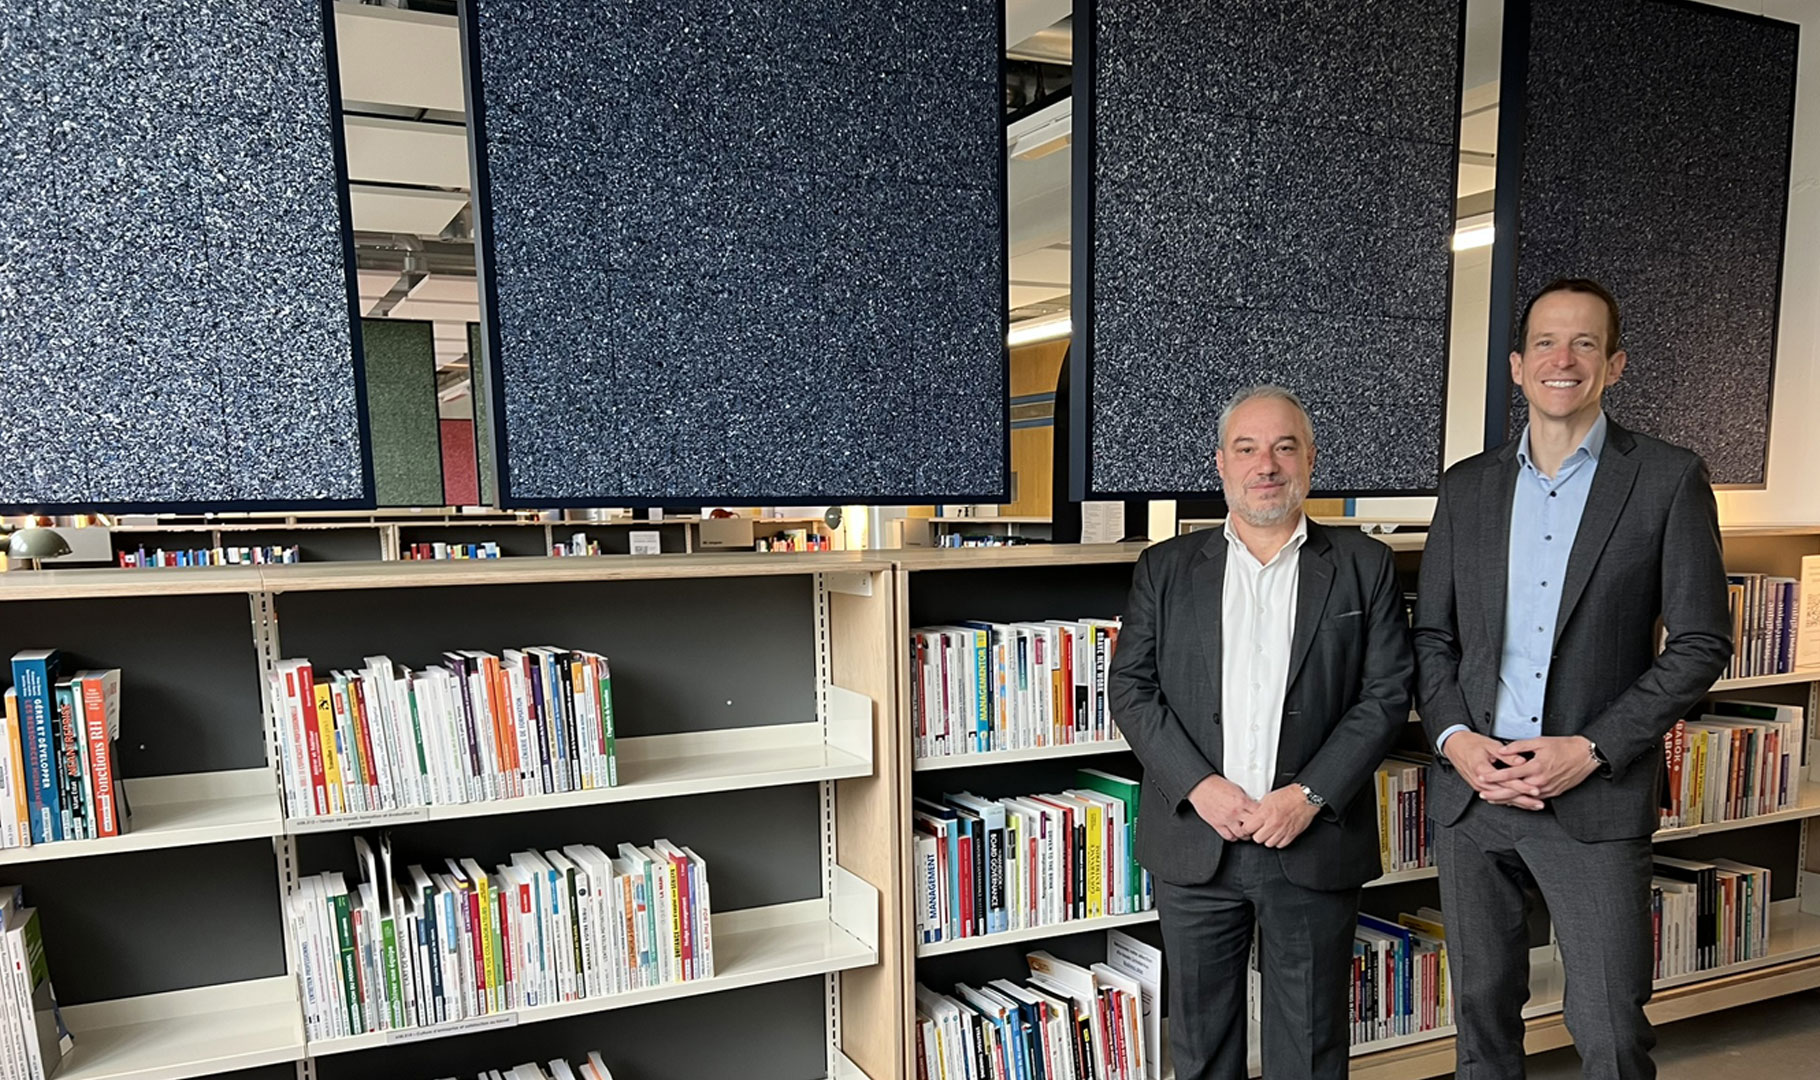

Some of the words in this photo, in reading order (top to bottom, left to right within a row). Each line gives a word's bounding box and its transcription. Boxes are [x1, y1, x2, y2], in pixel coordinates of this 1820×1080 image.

[25, 700, 34, 714] LES
[977, 649, 987, 720] MANAGEMENTOR
[34, 699, 45, 723] GÉRER
[89, 721, 104, 740] RH
[27, 716, 38, 765] RESSOURCES
[38, 738, 51, 788] DÉVELOPPER
[93, 742, 109, 797] Fonctions
[990, 833, 998, 857] BOARD
[927, 854, 937, 919] MANAGEMENT
[990, 858, 999, 906] GOVERNANCE
